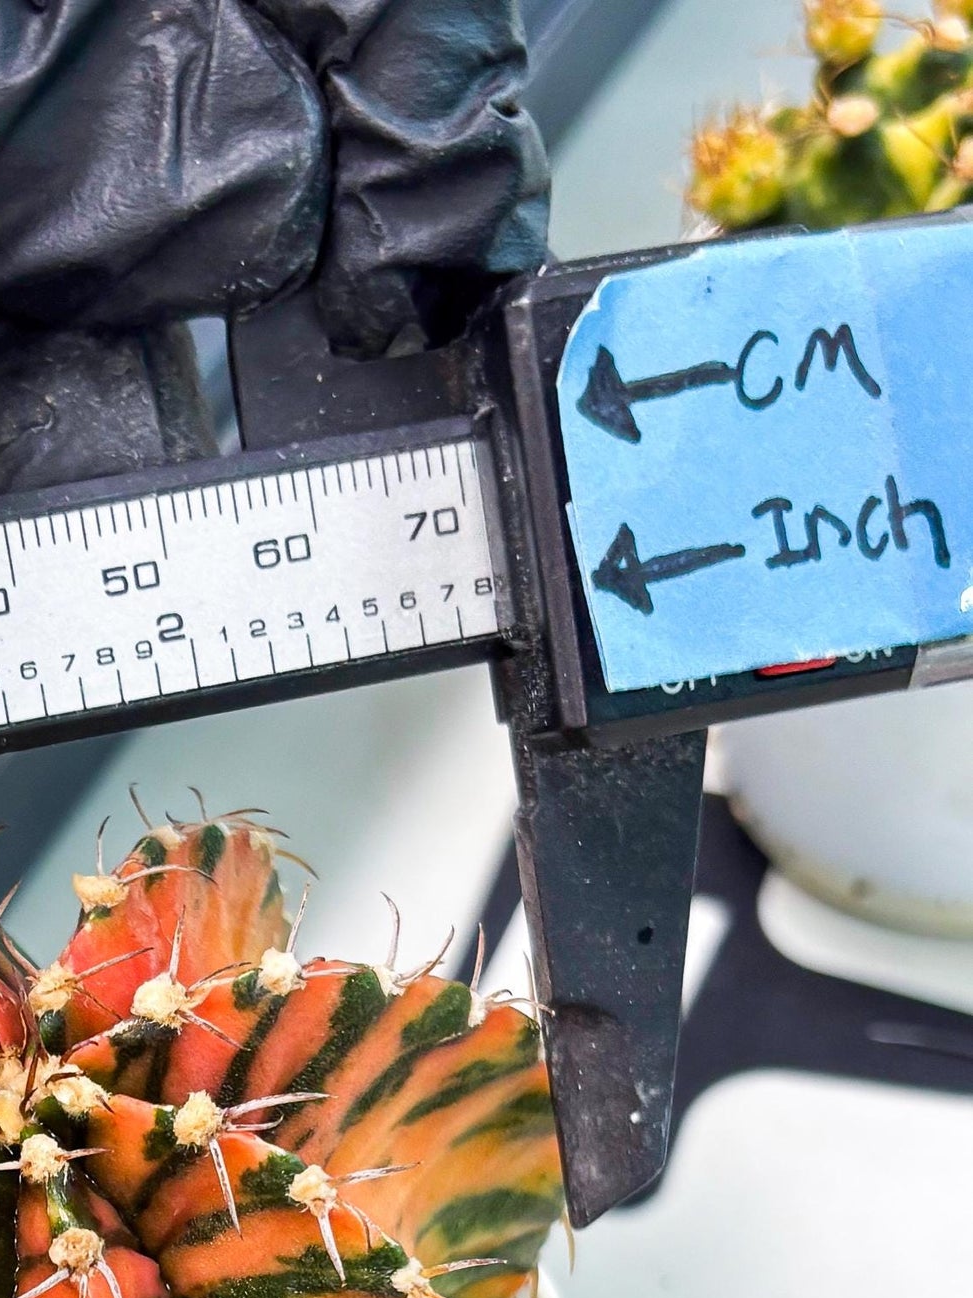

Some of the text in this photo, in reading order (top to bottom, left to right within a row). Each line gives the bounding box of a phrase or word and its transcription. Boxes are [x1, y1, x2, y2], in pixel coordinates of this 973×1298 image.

[100, 560, 161, 597] 50
[252, 533, 312, 570] 60
[403, 506, 460, 542] 70
[750, 474, 952, 569] Inch
[19, 660, 38, 681] 6
[60, 653, 76, 673] 7
[95, 646, 116, 666] 8
[134, 640, 154, 661] 9
[155, 612, 186, 644] 2
[219, 625, 228, 644] 1
[248, 618, 268, 639] 2
[286, 611, 305, 630] 3
[324, 603, 341, 623] 4
[361, 597, 379, 618] 5
[399, 590, 418, 611] 6
[440, 583, 455, 603] 7
[473, 576, 493, 596] 8
